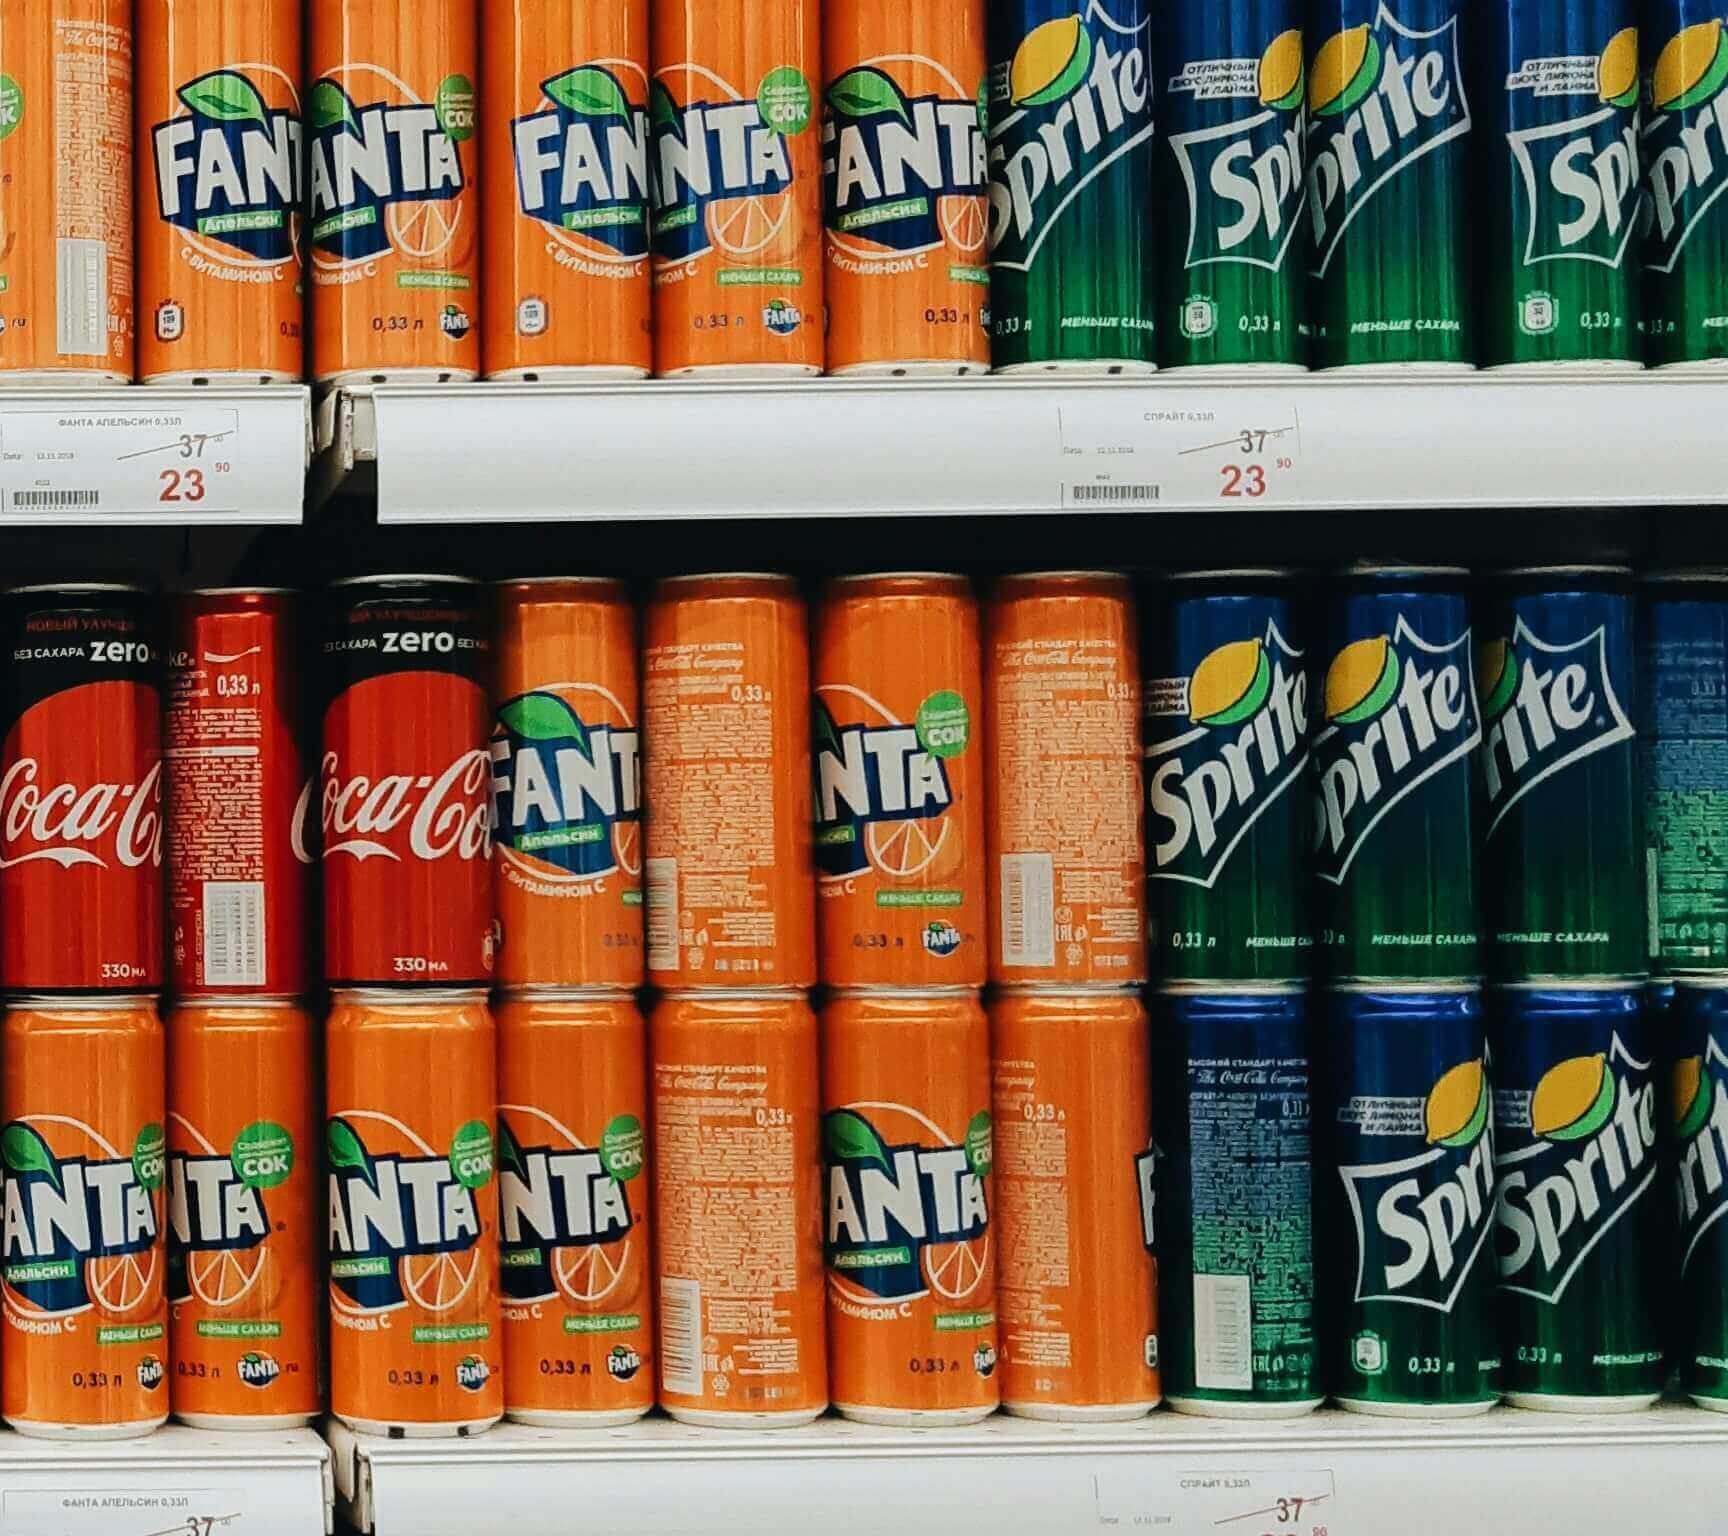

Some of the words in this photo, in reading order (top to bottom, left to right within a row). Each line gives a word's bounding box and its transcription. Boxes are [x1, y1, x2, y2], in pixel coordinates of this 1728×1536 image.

[1304, 46, 1448, 247] prite
[1239, 316, 1268, 333] 0,33
[179, 434, 208, 458] 37
[1240, 430, 1266, 453] 37
[159, 469, 205, 502] 23
[215, 462, 230, 473] 90
[1220, 465, 1266, 497] 23
[1276, 458, 1292, 469] 90
[382, 629, 454, 653] zero
[217, 674, 248, 697] 0,33
[522, 828, 598, 848] Апельсин
[1173, 931, 1202, 948] 0,33
[394, 957, 428, 973] 330
[244, 1156, 288, 1177] СОК
[4, 1159, 156, 1255] ANTA
[73, 1370, 108, 1387] 0,33
[541, 1358, 574, 1376] 0,33
[1276, 1498, 1303, 1522] 37
